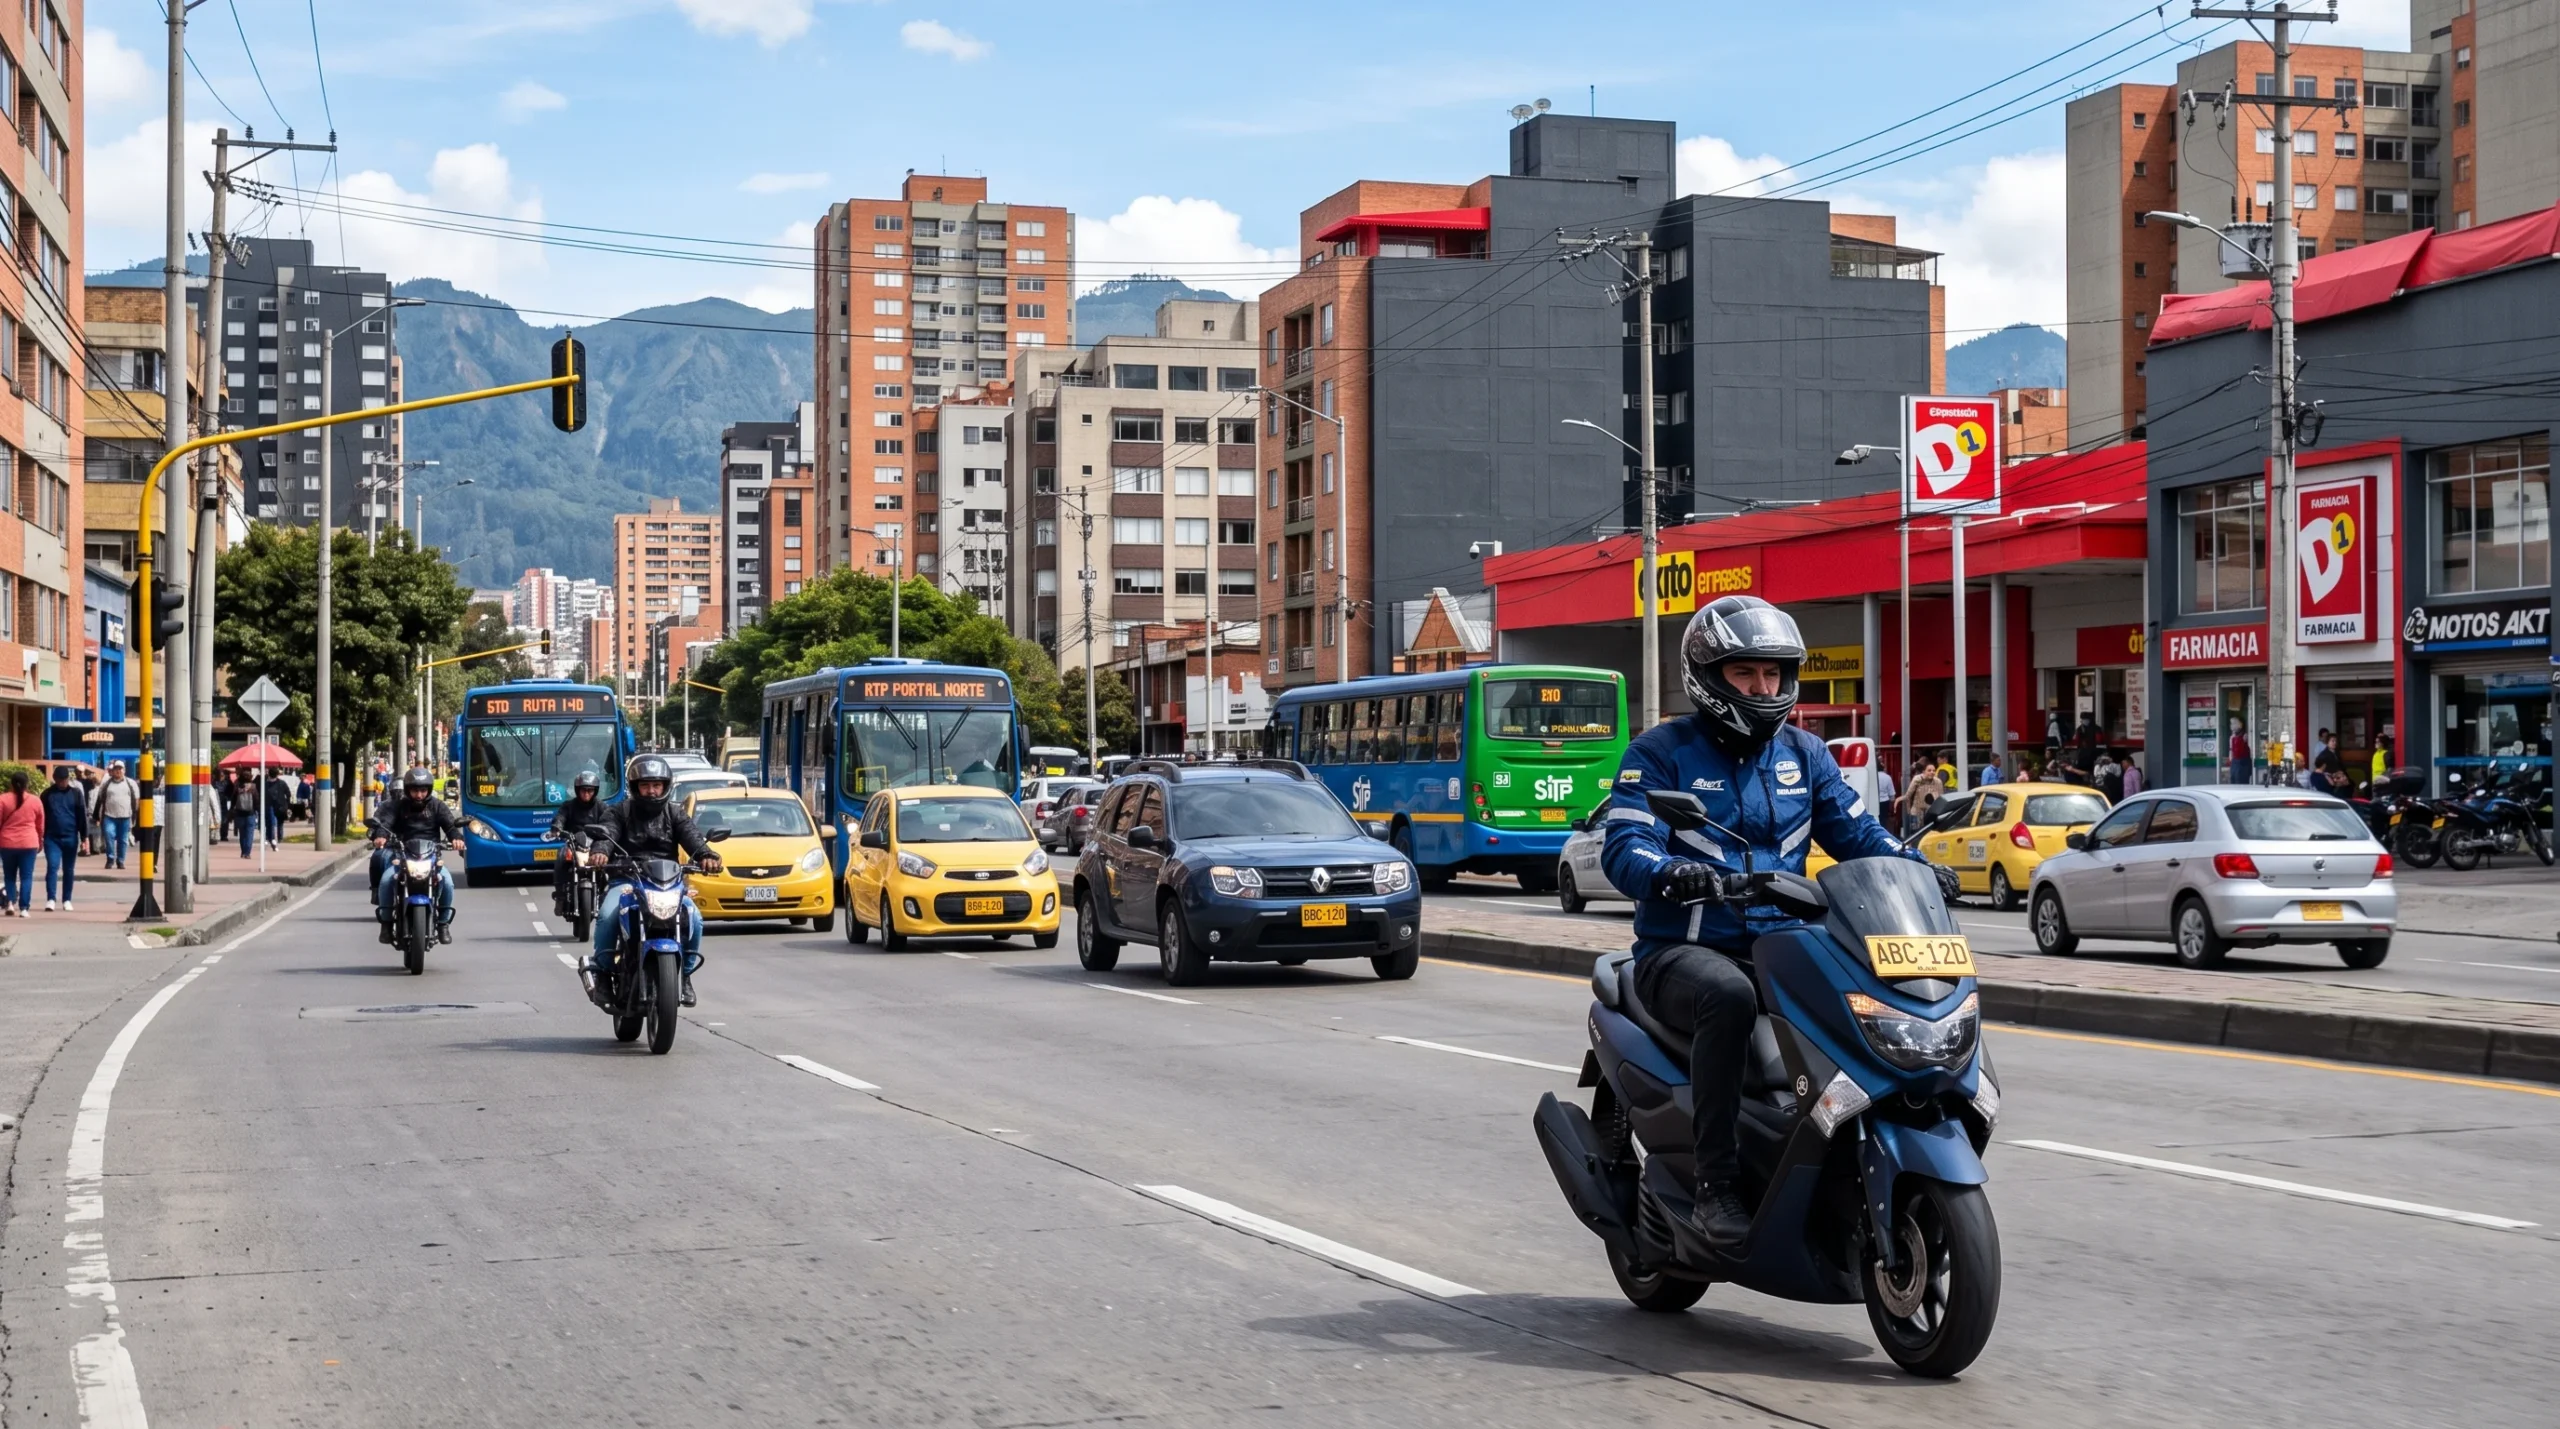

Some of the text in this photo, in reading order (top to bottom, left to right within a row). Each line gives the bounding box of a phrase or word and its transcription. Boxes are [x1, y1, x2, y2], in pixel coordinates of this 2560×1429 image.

[2311, 494, 2350, 509] FARMACIA
[2305, 621, 2357, 637] FARMACIA
[2428, 608, 2551, 640] MOTOS AKT
[2170, 631, 2259, 661] FARMACIA
[864, 682, 986, 697] RTP PORTAL NORTE
[523, 698, 556, 712] RUTA
[1876, 942, 1968, 965] ABC-12D
